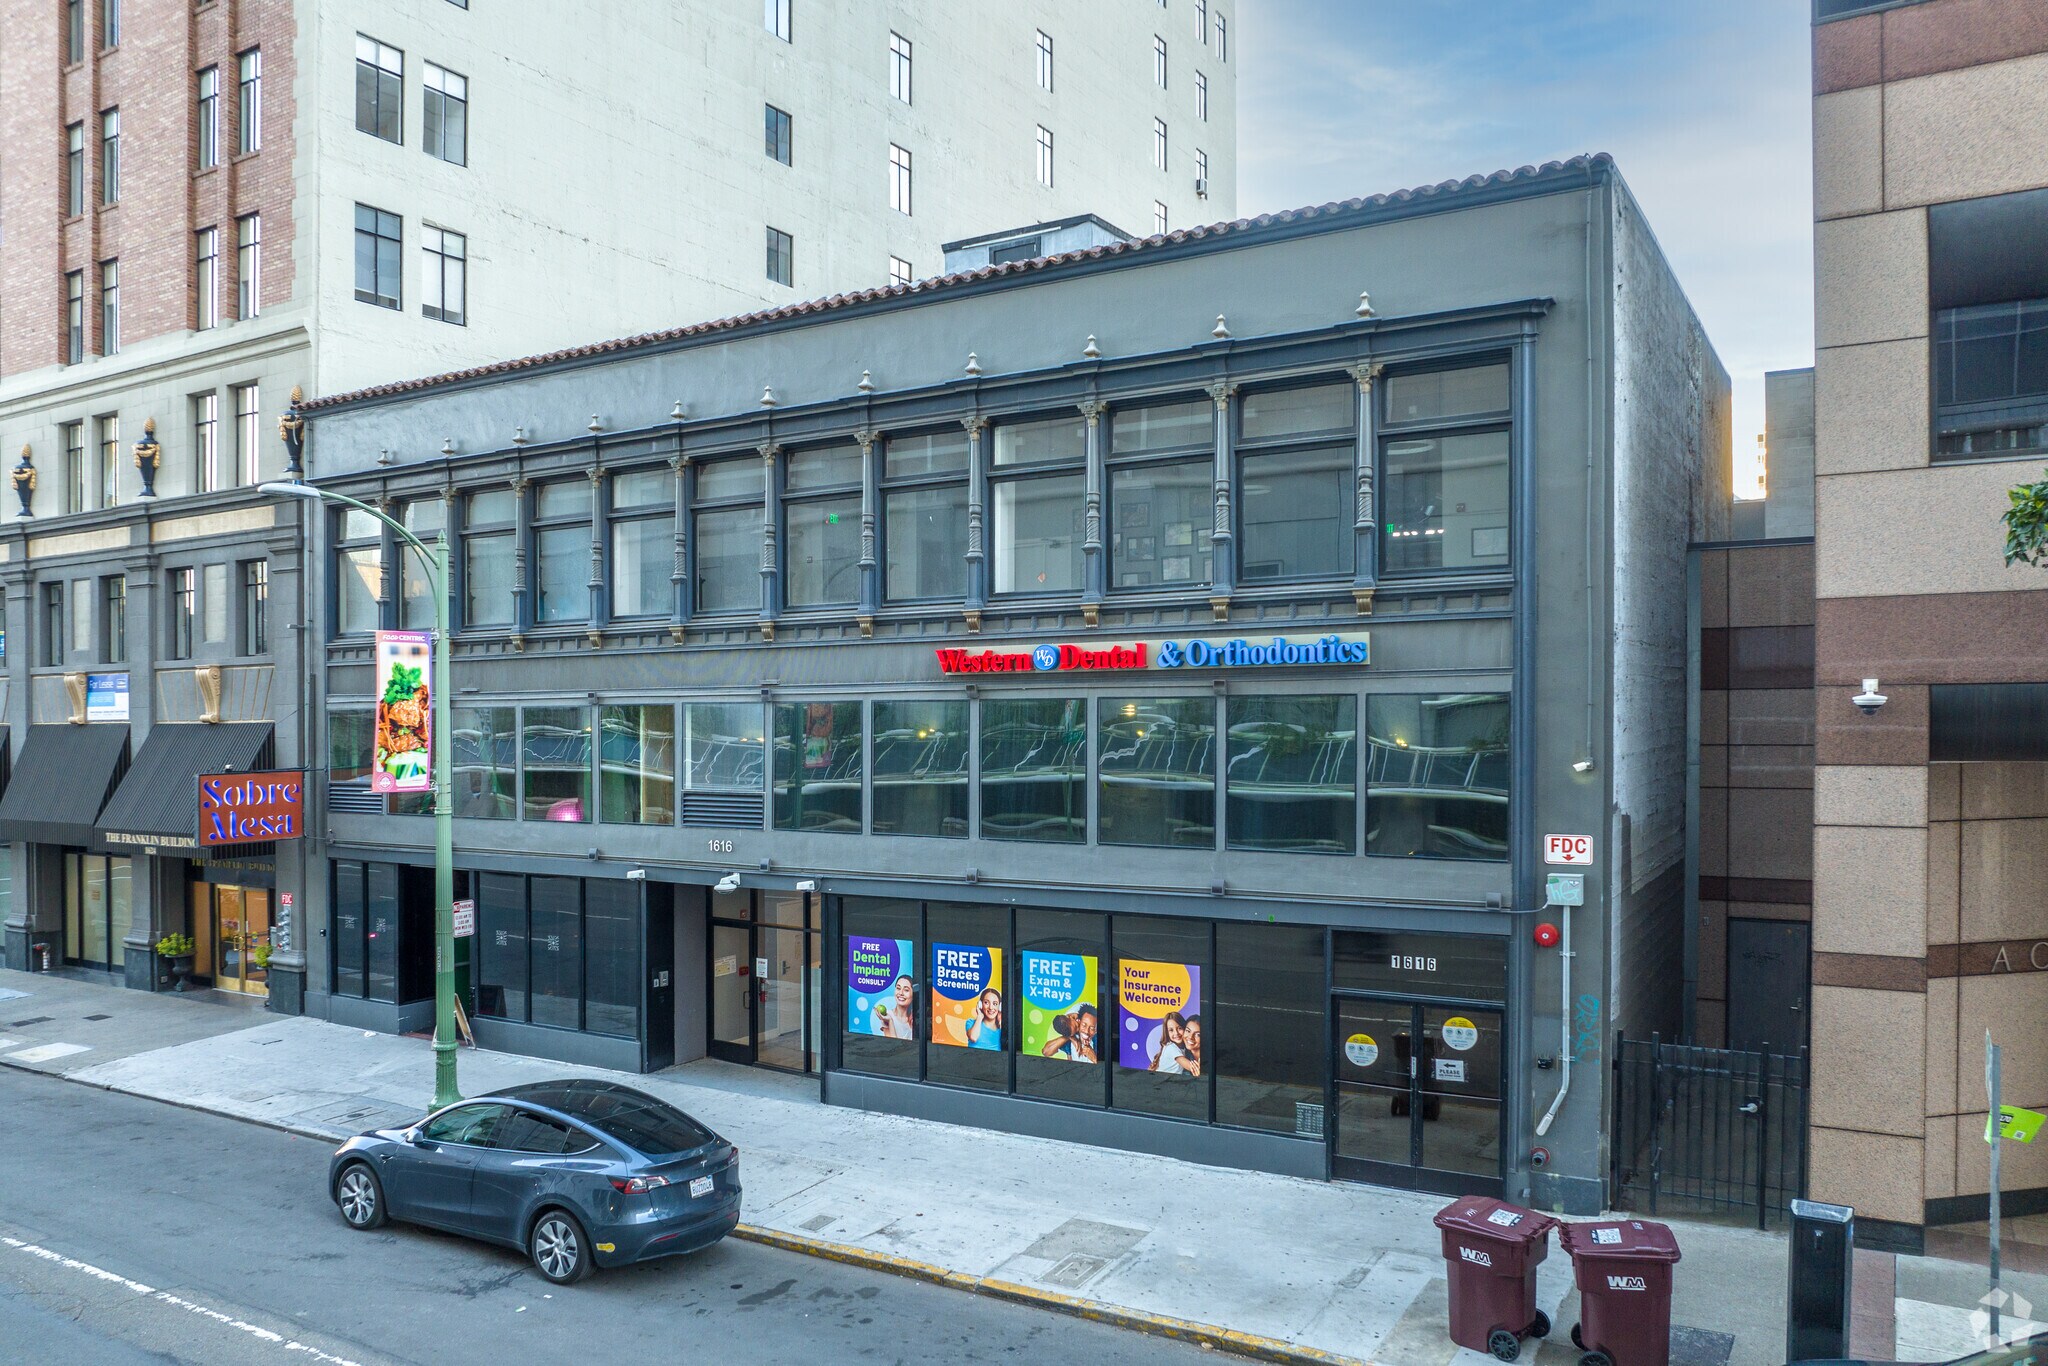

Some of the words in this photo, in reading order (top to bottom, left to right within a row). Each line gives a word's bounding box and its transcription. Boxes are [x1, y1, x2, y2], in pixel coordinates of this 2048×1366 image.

[935, 648, 1035, 673] Western
[1058, 643, 1148, 670] Dental
[1156, 641, 1184, 668] &
[1185, 635, 1367, 667] Orthodontics
[99, 680, 114, 689] Lease
[203, 780, 300, 808] Sobre
[209, 811, 294, 840] Mesa
[105, 832, 120, 843] THE
[121, 833, 159, 845] FRANKLIN
[1551, 838, 1587, 854] FDC
[708, 840, 733, 853] 1616
[281, 894, 293, 904] FDC
[862, 942, 880, 951] FREE
[853, 950, 891, 965] Dental
[1392, 955, 1436, 970] 1616
[853, 963, 891, 977] Implant
[937, 966, 980, 981] Braces
[1124, 967, 1150, 979] Your
[937, 978, 980, 993] Screening
[1029, 974, 1060, 987] Exam
[1063, 978, 1072, 989] &
[1124, 979, 1182, 994] Insurance
[1029, 986, 1072, 1002] X-Rays
[1124, 991, 1181, 1007] Welcome!
[1459, 1246, 1492, 1265] WM
[1607, 1275, 1647, 1289] WM
